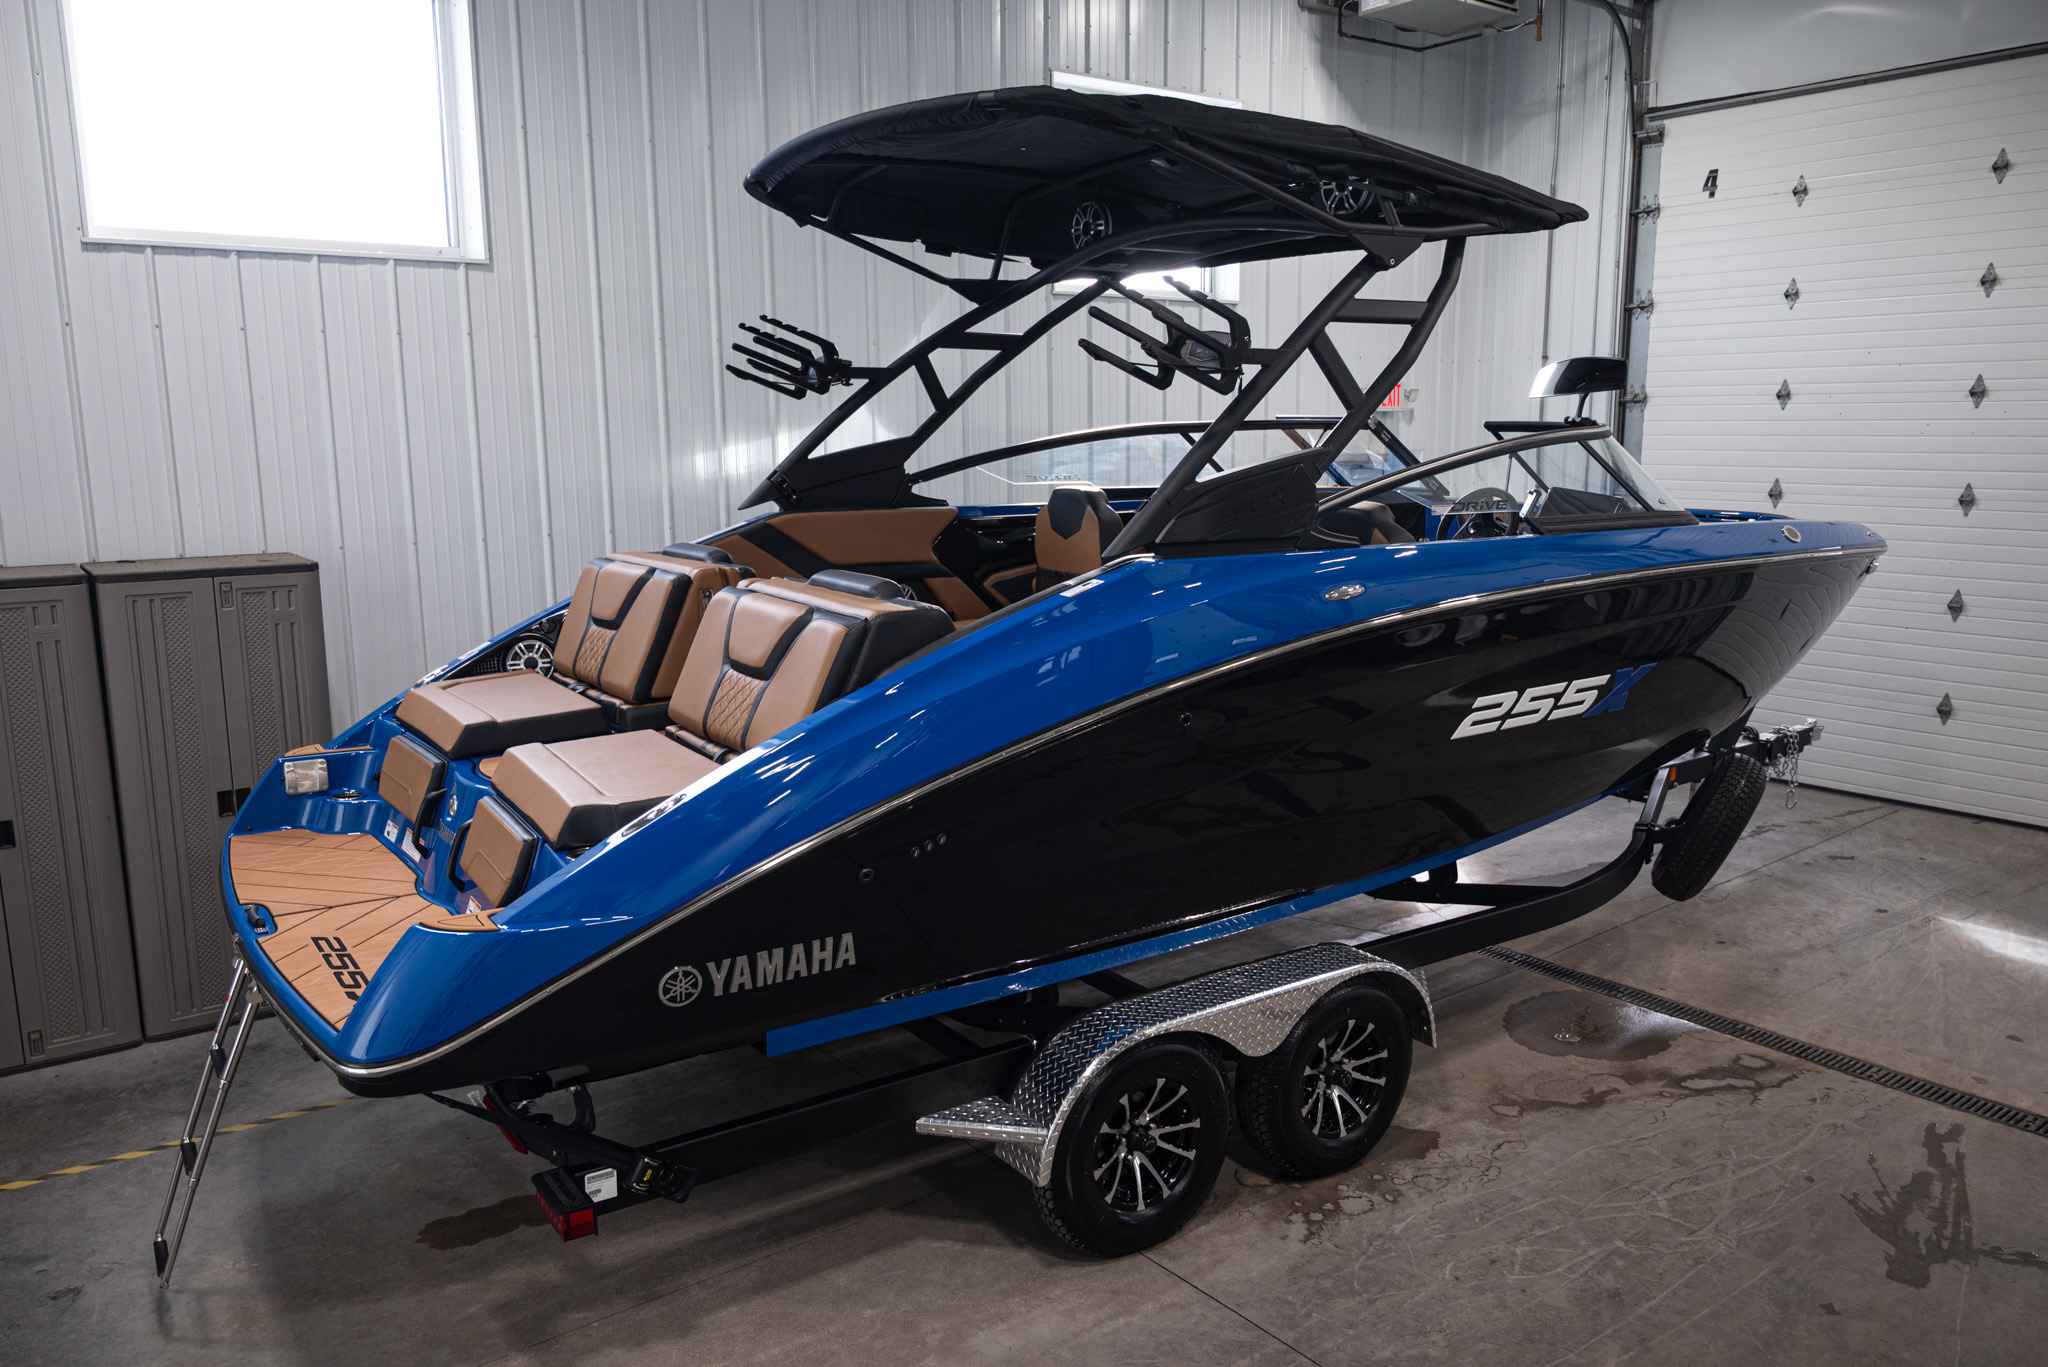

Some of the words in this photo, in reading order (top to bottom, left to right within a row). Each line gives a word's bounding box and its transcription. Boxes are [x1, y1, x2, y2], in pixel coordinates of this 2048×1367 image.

[1702, 168, 1719, 199] 4
[1381, 384, 1402, 407] XIT
[1450, 662, 1658, 740] 255X
[706, 932, 857, 997] YAMAHA
